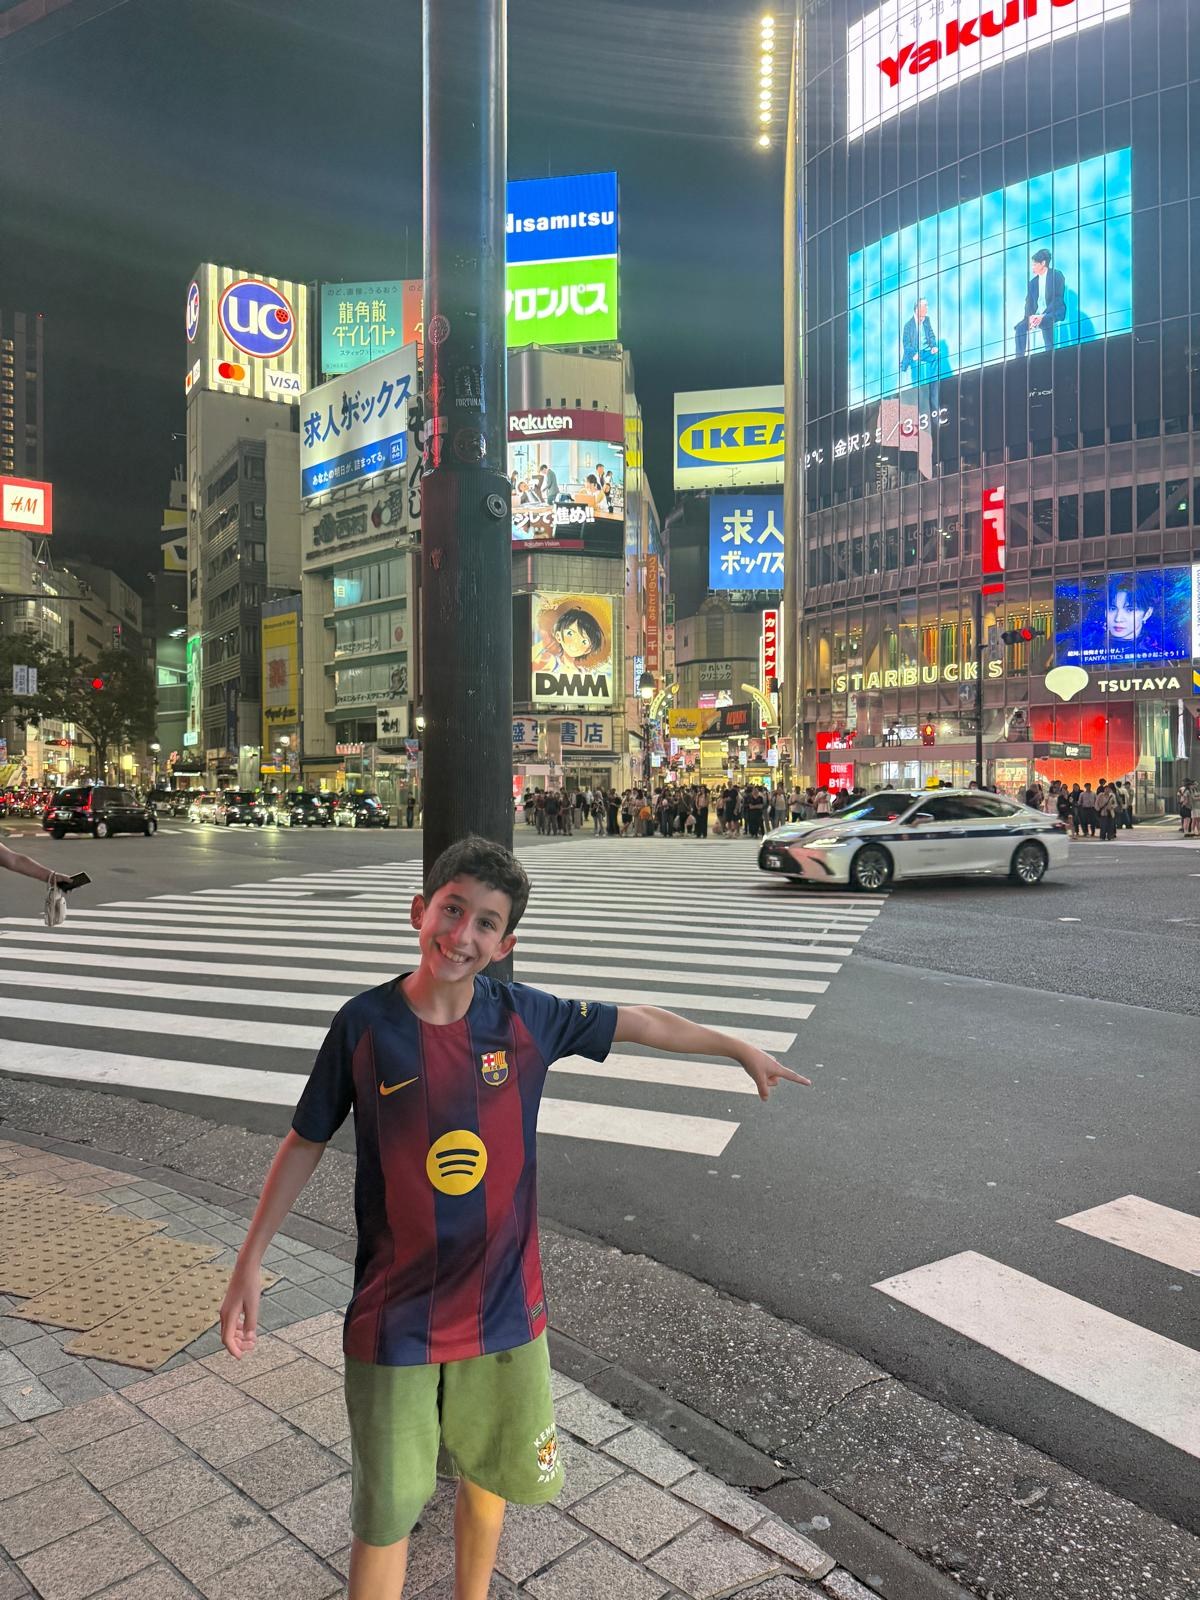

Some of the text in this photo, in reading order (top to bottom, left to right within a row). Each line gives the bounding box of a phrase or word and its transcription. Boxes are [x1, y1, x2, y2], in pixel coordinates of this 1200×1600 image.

[338, 300, 386, 324] 龍角散
[268, 374, 300, 391] VISA
[303, 374, 412, 449] 求人ボックス
[509, 414, 573, 432] Rakuten
[720, 509, 784, 545] 求人
[720, 550, 784, 575] ボックス
[765, 617, 776, 670] カラオケ
[535, 673, 610, 697] DMM
[836, 659, 1003, 692] STARBUCKS
[1098, 676, 1181, 693] TSUTAYA
[828, 777, 846, 788] B1F
